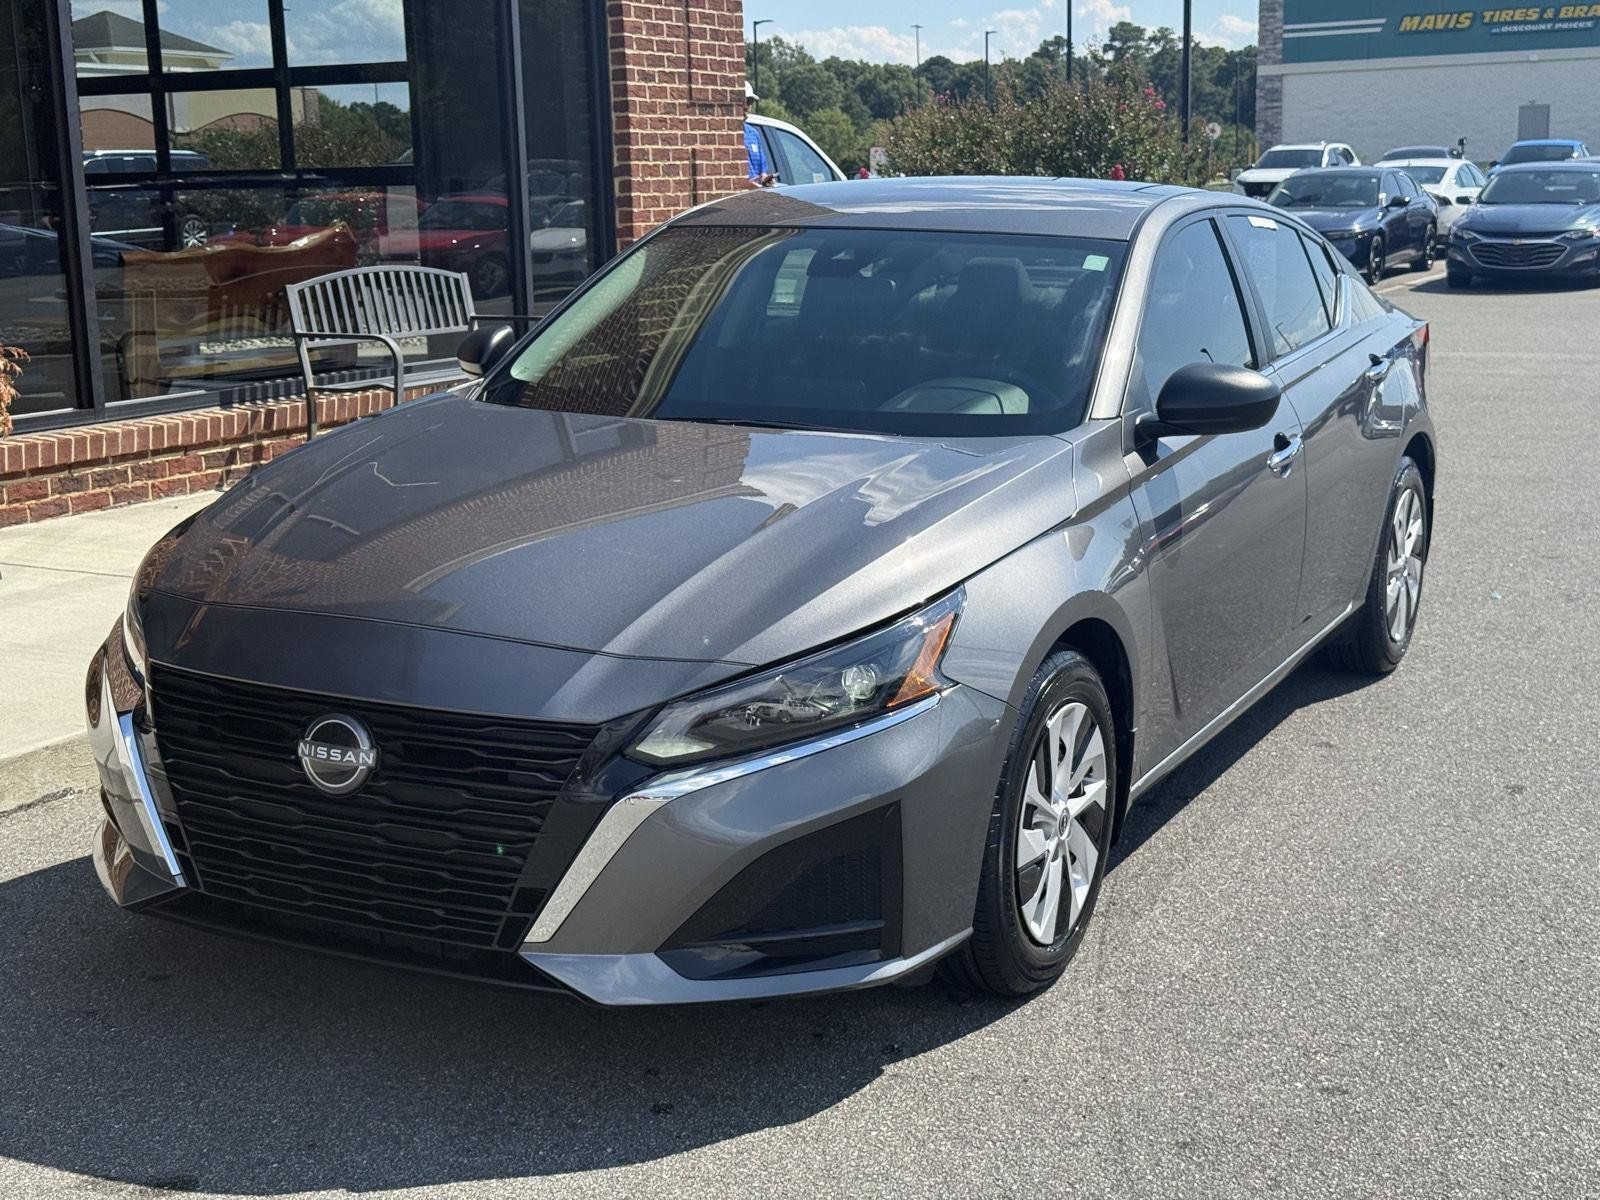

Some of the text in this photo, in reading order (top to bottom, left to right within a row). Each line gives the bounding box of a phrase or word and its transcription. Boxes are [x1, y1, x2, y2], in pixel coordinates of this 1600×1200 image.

[1399, 12, 1473, 31] MAVIS
[1483, 7, 1540, 23] TIRES
[1543, 7, 1555, 18] &
[1501, 22, 1553, 32] DISCOUNT
[298, 742, 374, 764] NISSAN
